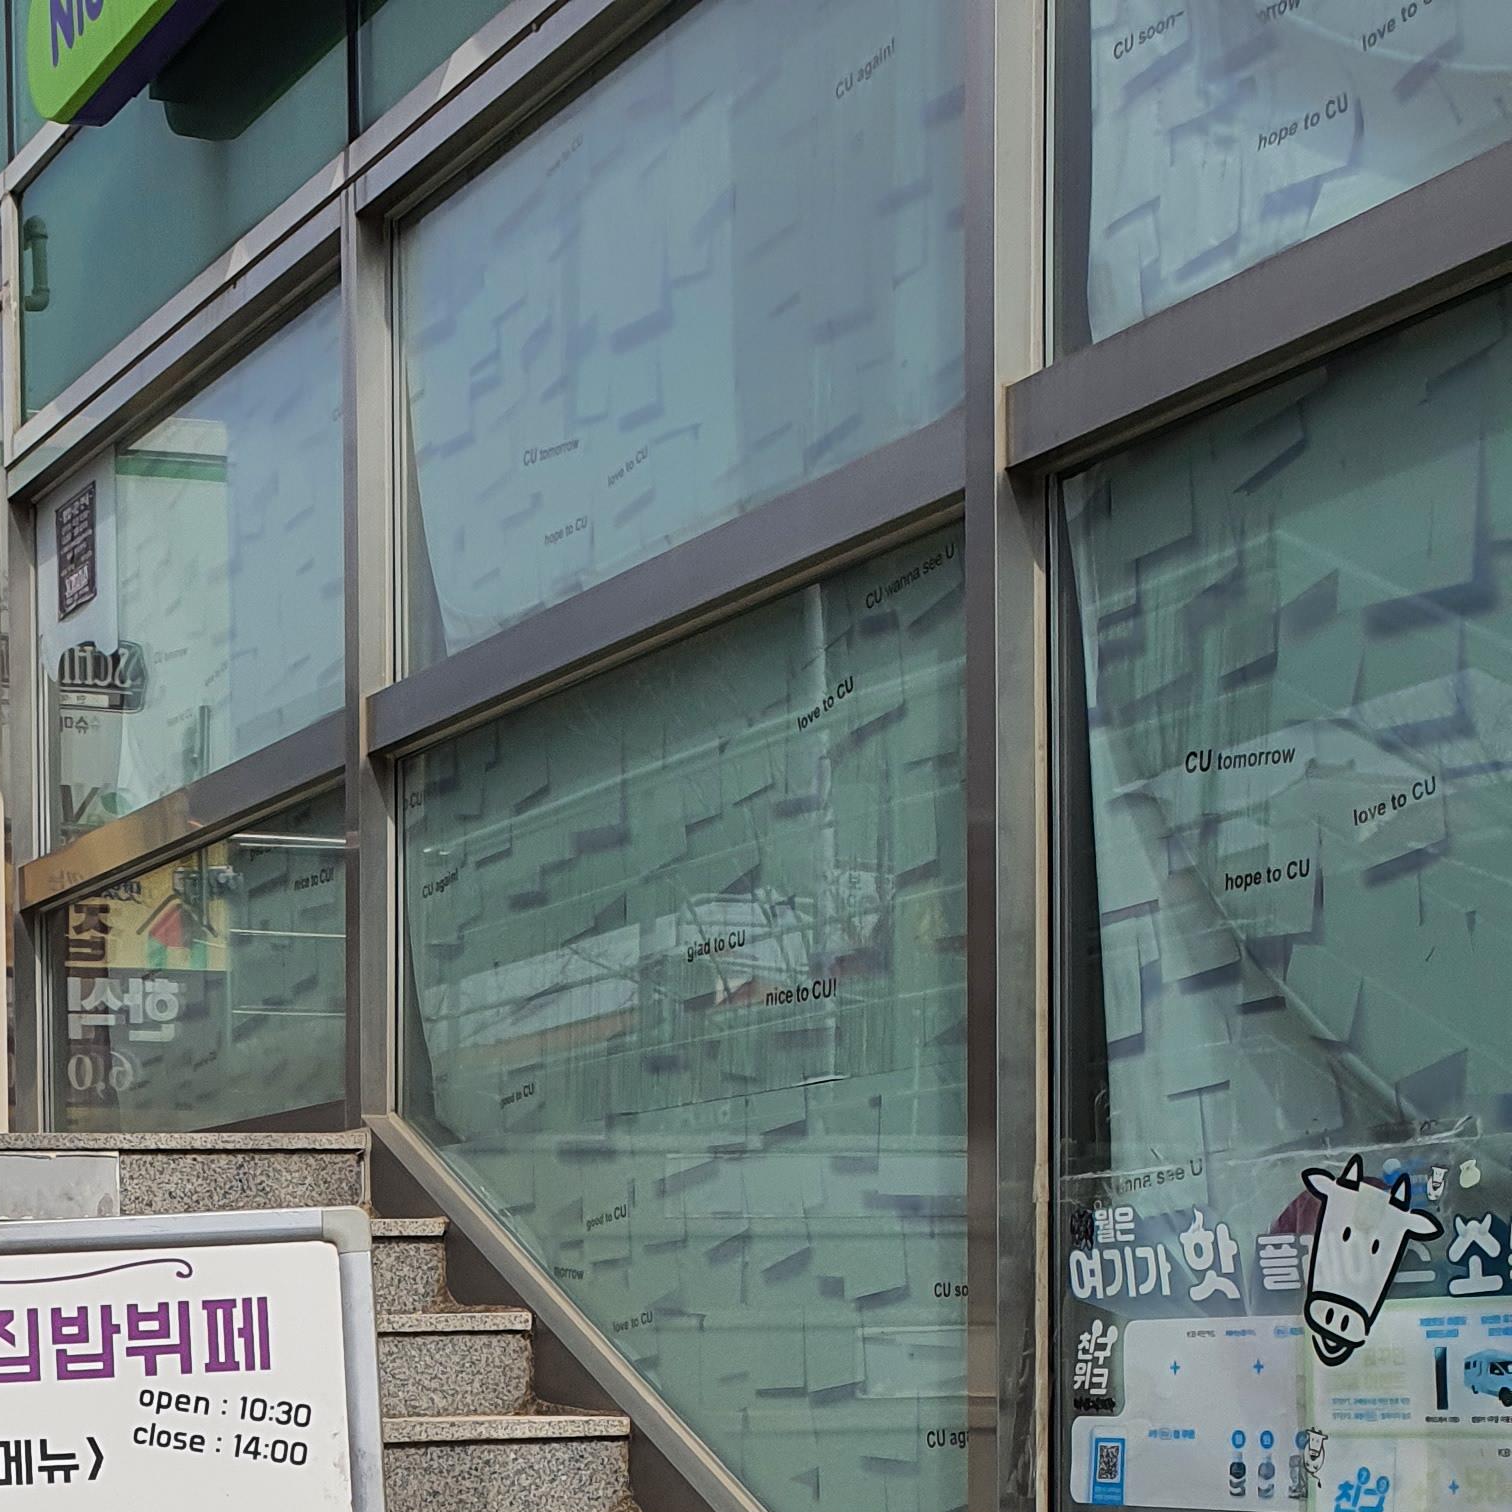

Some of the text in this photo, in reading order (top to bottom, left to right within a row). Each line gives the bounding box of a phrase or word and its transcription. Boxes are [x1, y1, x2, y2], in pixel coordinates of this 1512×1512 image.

[1362, 2, 1418, 51] love to
[1113, 33, 1134, 59] CU
[836, 72, 854, 99] CU
[1257, 92, 1348, 152] hope to CU
[523, 447, 538, 466] CU
[607, 468, 624, 487] love
[635, 445, 648, 464] CU
[575, 516, 588, 531] CU
[866, 543, 955, 609] CU wanna see U
[797, 675, 854, 731] love to CU
[1184, 745, 1296, 773] CU tomorrow
[1353, 776, 1437, 826] love to CU
[1224, 858, 1310, 891] hope to CU
[422, 882, 434, 898] CU
[687, 929, 746, 962] glad to CU
[766, 978, 838, 1006] nice to CU!
[523, 1082, 535, 1097] CU
[1156, 1165, 1185, 1186] see
[1190, 1158, 1204, 1176] U
[586, 1204, 627, 1232] good to CU
[1069, 1244, 1171, 1299] 여기가
[1178, 1205, 1240, 1301] 핫
[934, 1283, 969, 1297] CU so
[613, 1321, 629, 1333] love
[641, 1311, 653, 1325] CU
[1077, 1320, 1118, 1366] 친구
[1073, 1361, 1109, 1395] 위크
[137, 1389, 211, 1418] open
[238, 1395, 312, 1428] 10:30
[131, 1421, 206, 1454] close
[232, 1432, 309, 1466] 14:00
[927, 1430, 945, 1448] CU
